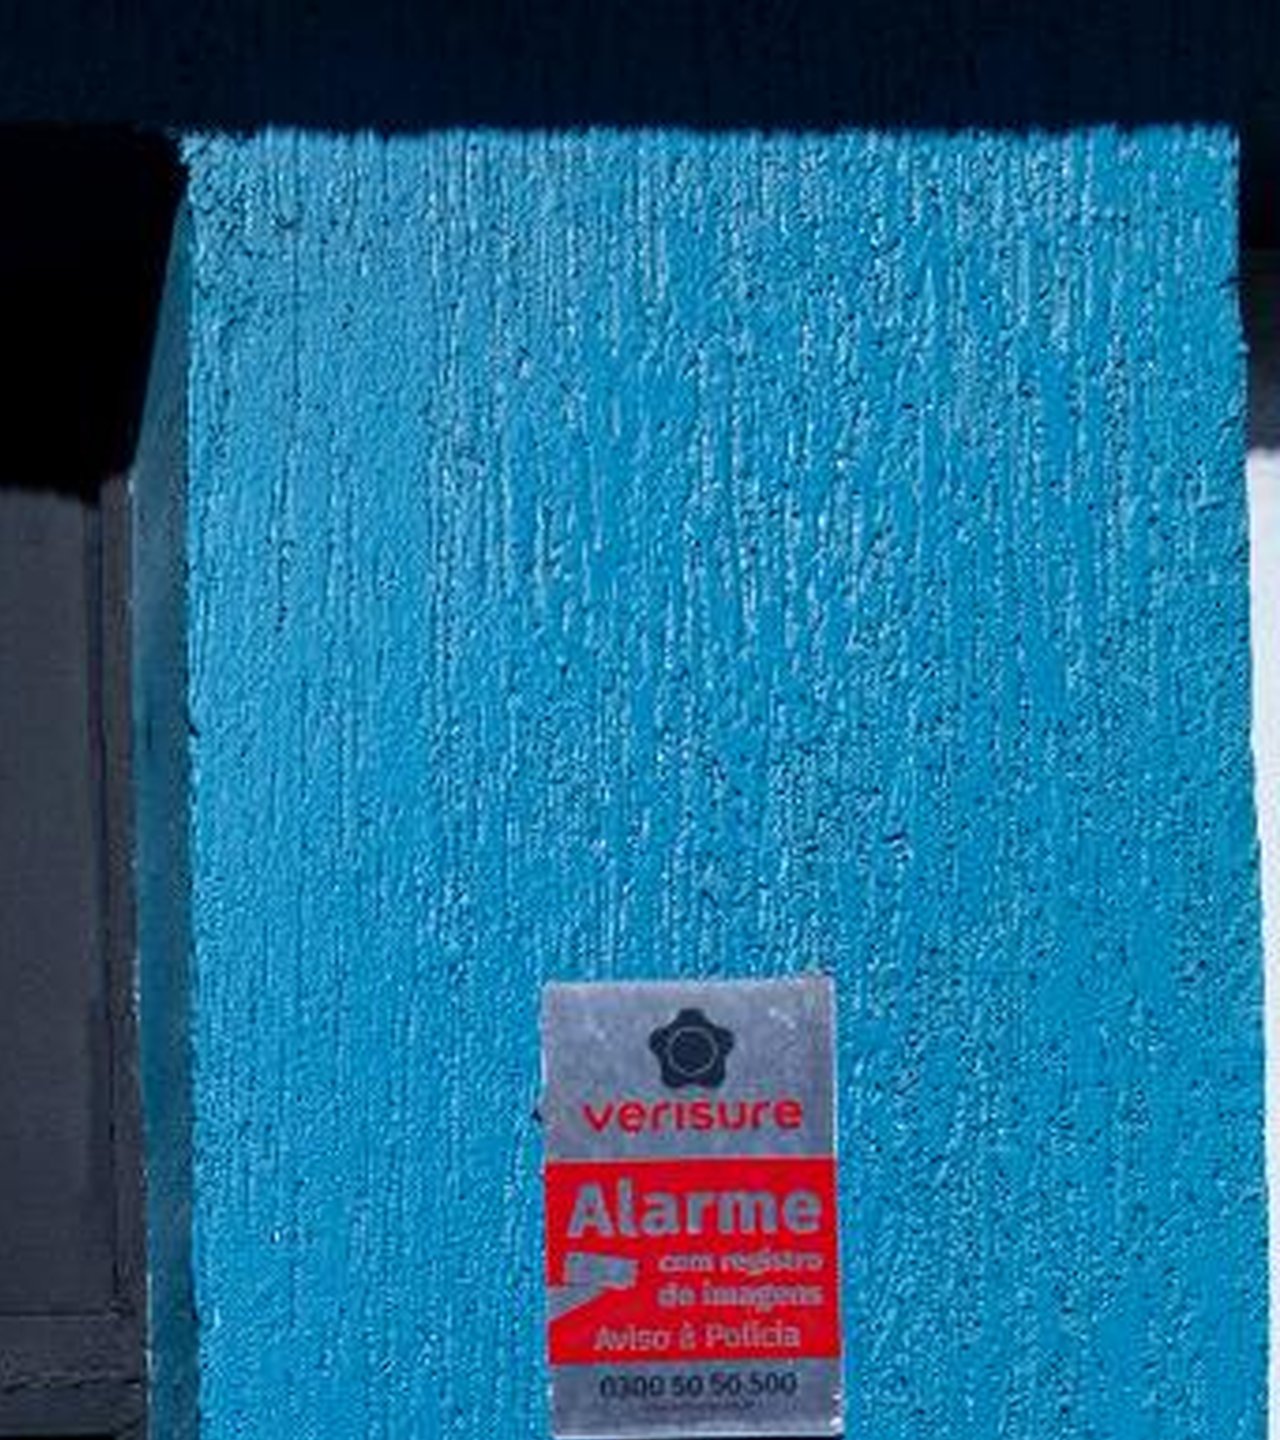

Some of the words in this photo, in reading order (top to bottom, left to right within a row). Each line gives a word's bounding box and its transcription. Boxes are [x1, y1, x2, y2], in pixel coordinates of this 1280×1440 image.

[582, 1097, 803, 1133] verisure
[566, 1178, 823, 1239] Alarme
[658, 1253, 714, 1273] com
[720, 1248, 824, 1276] registro
[658, 1283, 695, 1307] de
[702, 1279, 824, 1312] imagens
[593, 1324, 671, 1352] Aviso
[671, 1374, 703, 1398] 50
